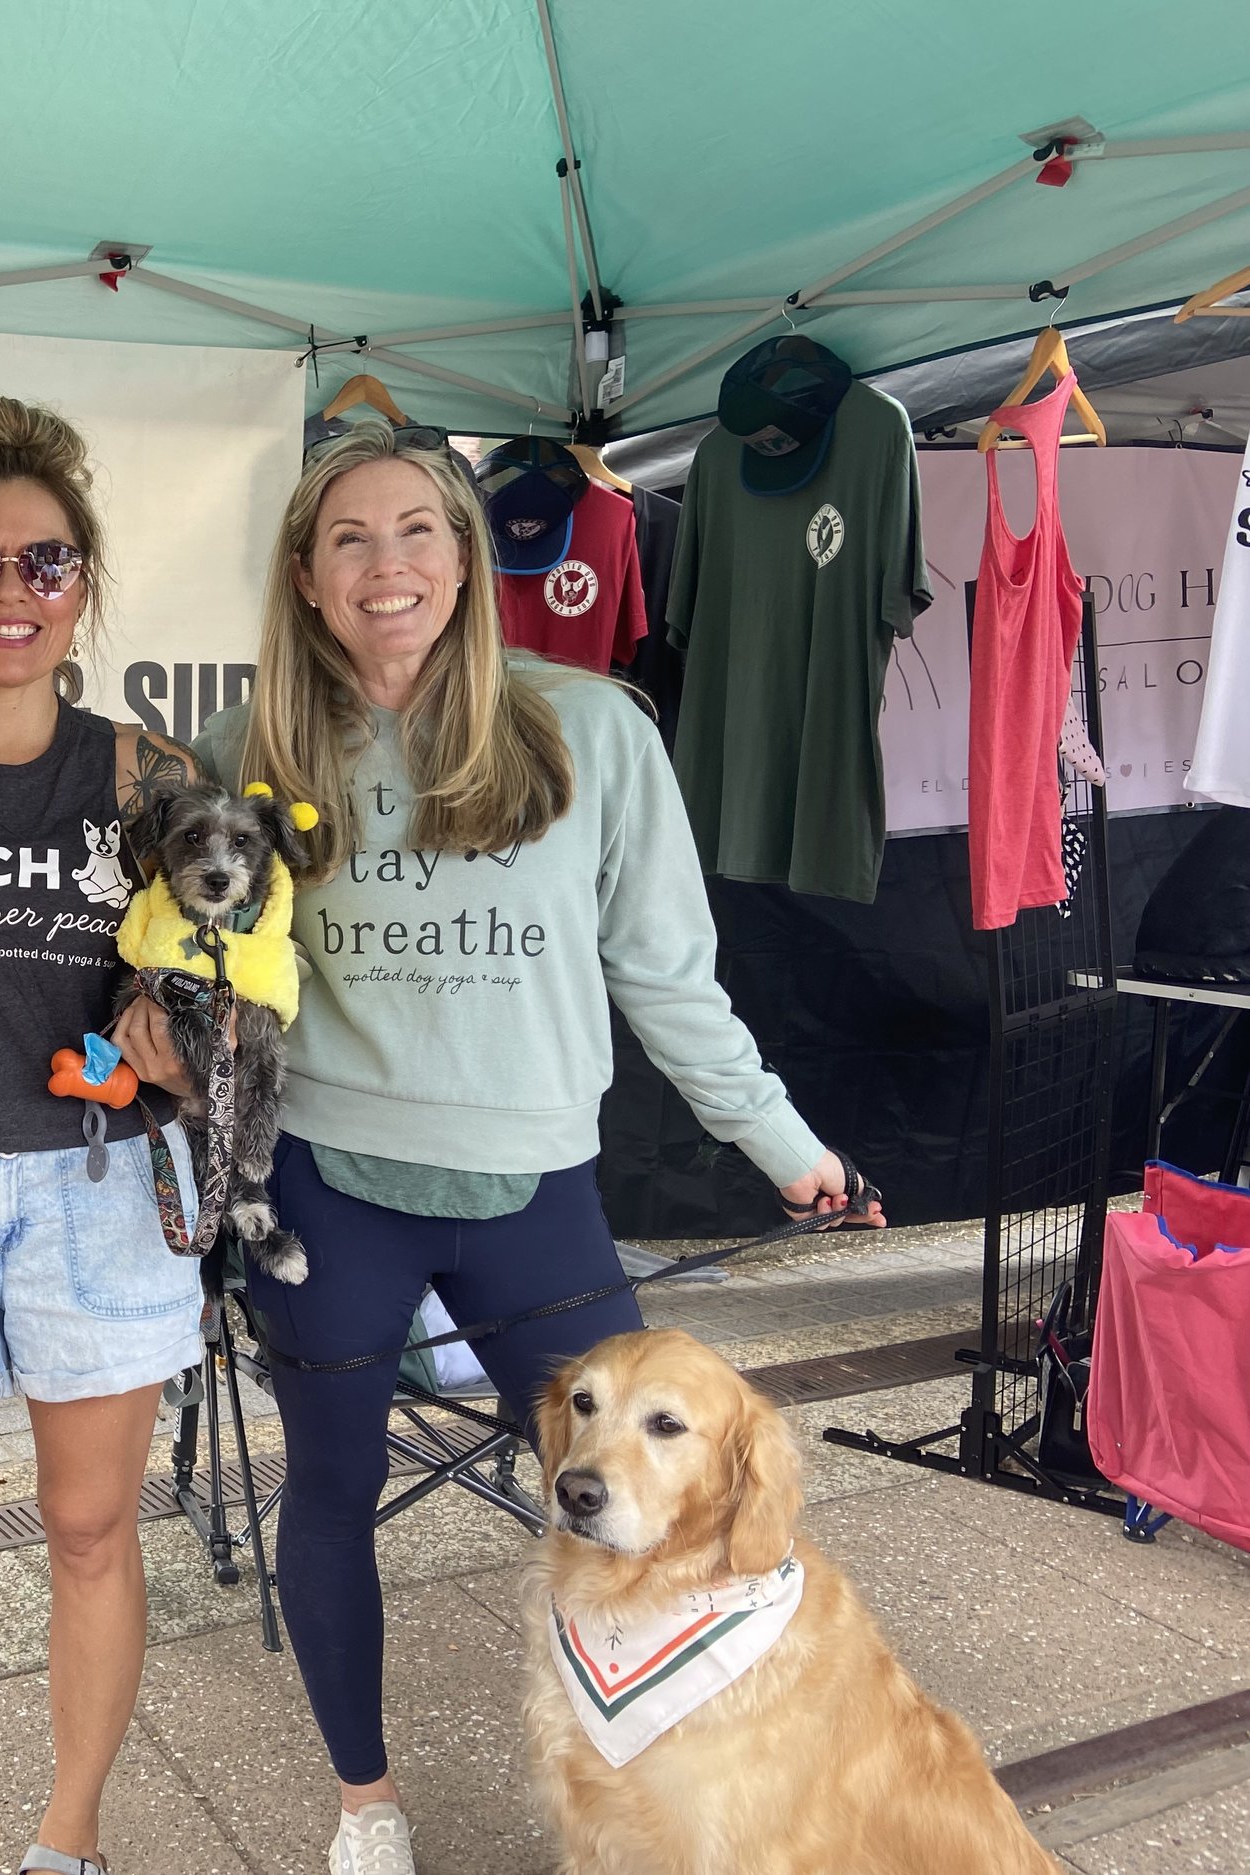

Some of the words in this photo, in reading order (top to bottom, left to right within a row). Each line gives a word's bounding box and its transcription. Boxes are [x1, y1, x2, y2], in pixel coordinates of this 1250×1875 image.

[548, 563, 583, 584] SPOTTED
[584, 571, 596, 587] DOG
[1084, 572, 1156, 614] DOG
[1098, 660, 1203, 692] SALO
[349, 840, 444, 891] tay
[45, 911, 119, 942] peac
[317, 906, 546, 957] breathe
[41, 949, 65, 965] dog
[67, 954, 93, 967] yoga
[94, 956, 102, 967] &
[342, 966, 403, 989] spotted
[406, 968, 435, 994] dog
[436, 975, 476, 995] yoga
[491, 975, 522, 993] sup
